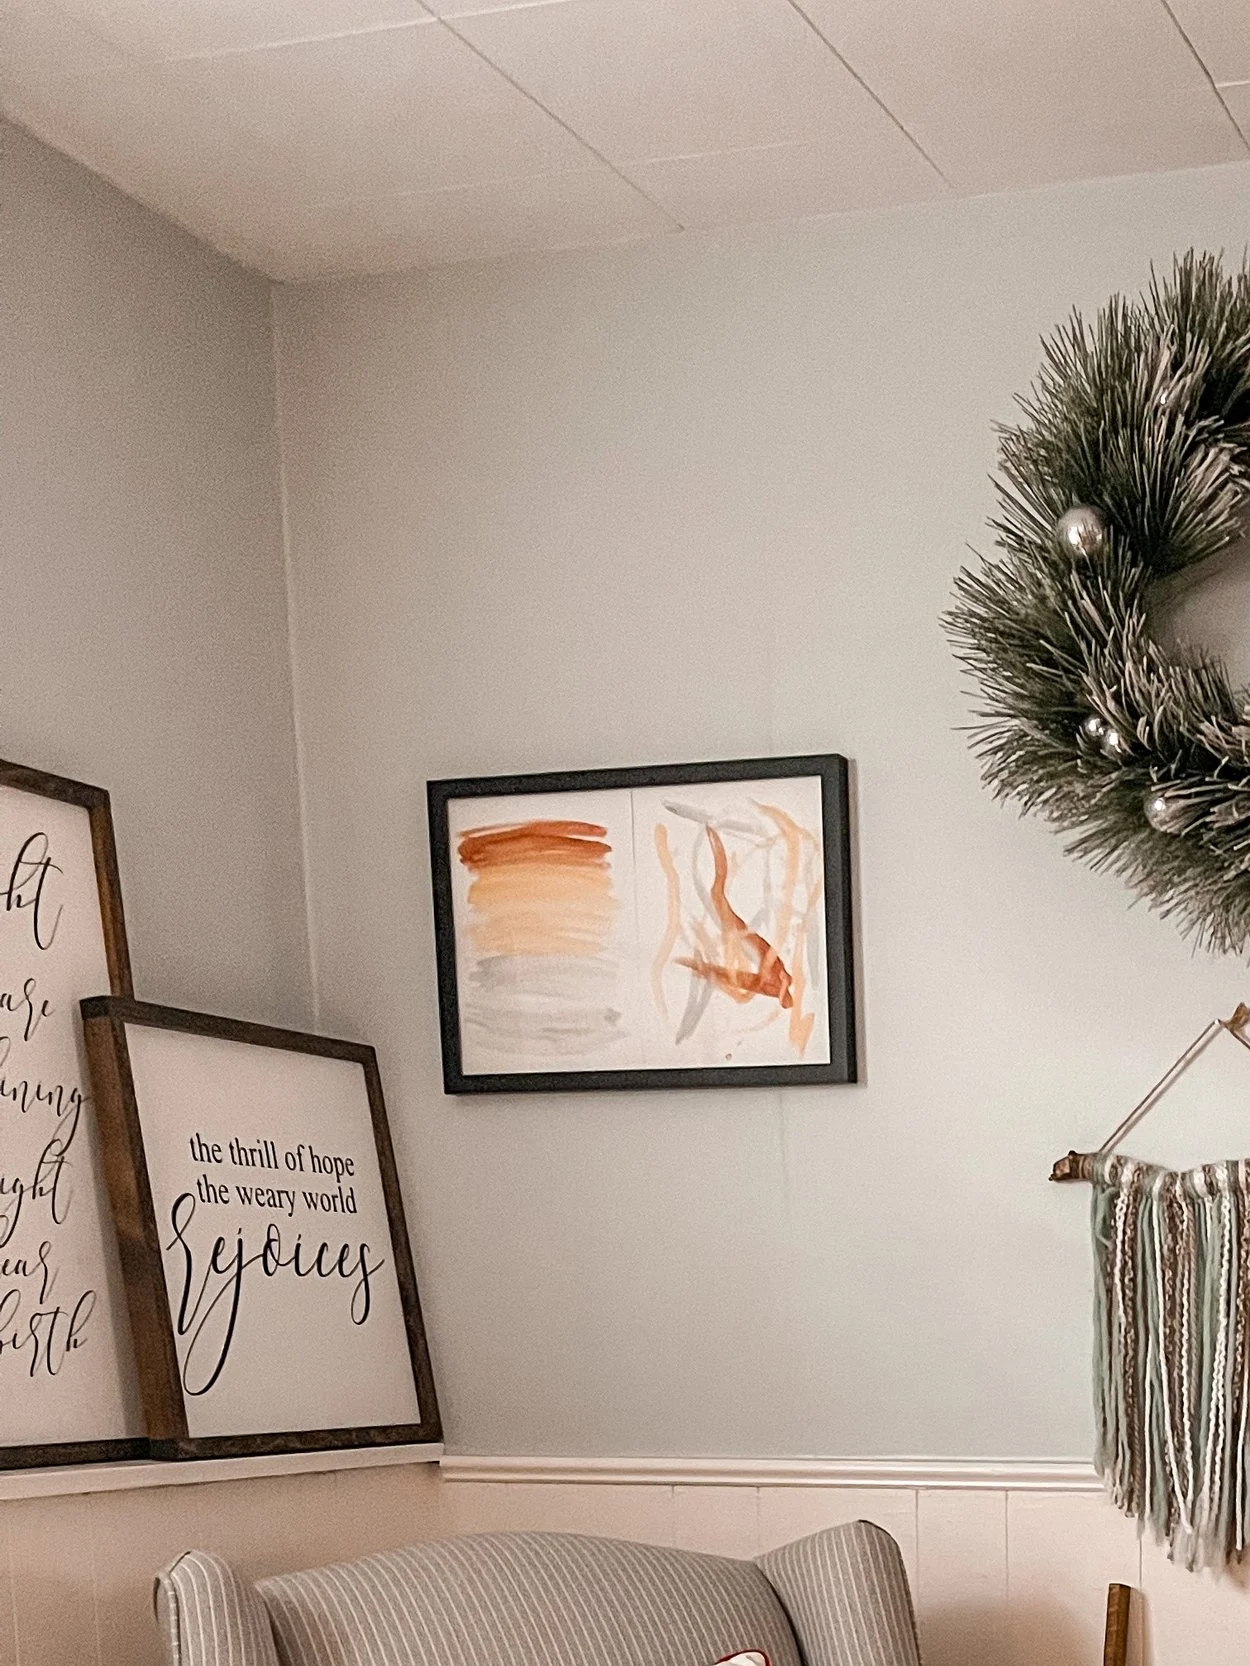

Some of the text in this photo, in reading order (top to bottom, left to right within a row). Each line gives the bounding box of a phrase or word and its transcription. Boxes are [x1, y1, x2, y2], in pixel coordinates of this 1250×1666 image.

[189, 1132, 355, 1183] the thrill of hope
[196, 1173, 358, 1217] the weary world
